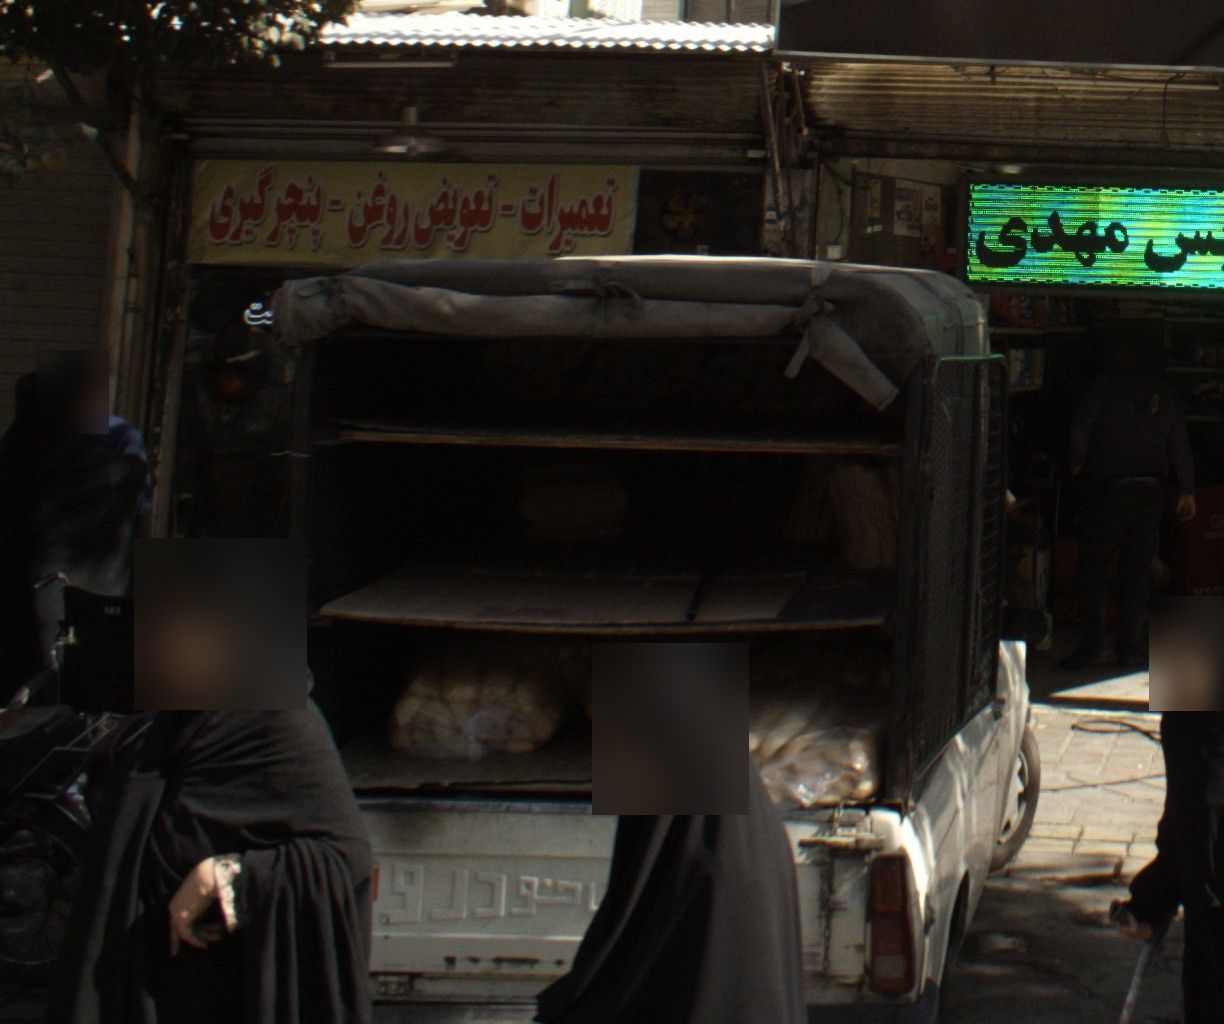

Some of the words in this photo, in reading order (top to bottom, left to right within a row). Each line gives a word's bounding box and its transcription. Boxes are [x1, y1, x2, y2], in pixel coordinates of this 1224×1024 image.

[346, 167, 411, 251] روغن
[413, 172, 498, 252] تعویض
[976, 210, 1130, 269] مهدی
[380, 863, 584, 924] خودرو
